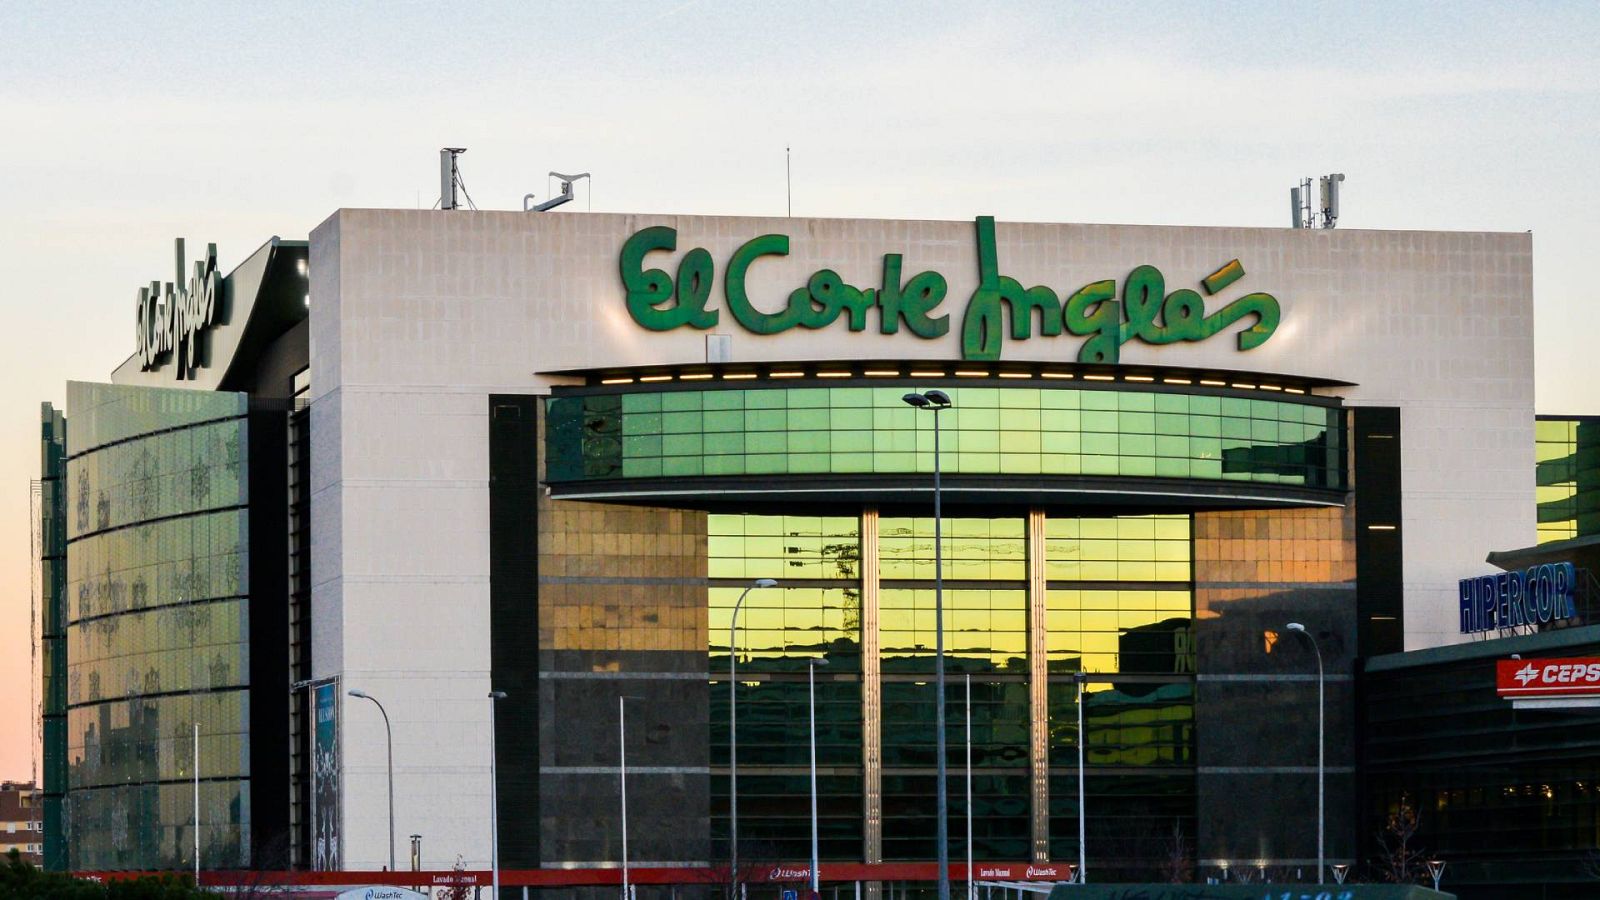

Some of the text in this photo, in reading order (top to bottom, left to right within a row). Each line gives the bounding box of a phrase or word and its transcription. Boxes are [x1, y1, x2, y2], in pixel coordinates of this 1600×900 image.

[619, 215, 1282, 366] El Corte Inglés
[1459, 561, 1577, 634] HIPERCOR
[374, 891, 403, 900] WashTec
